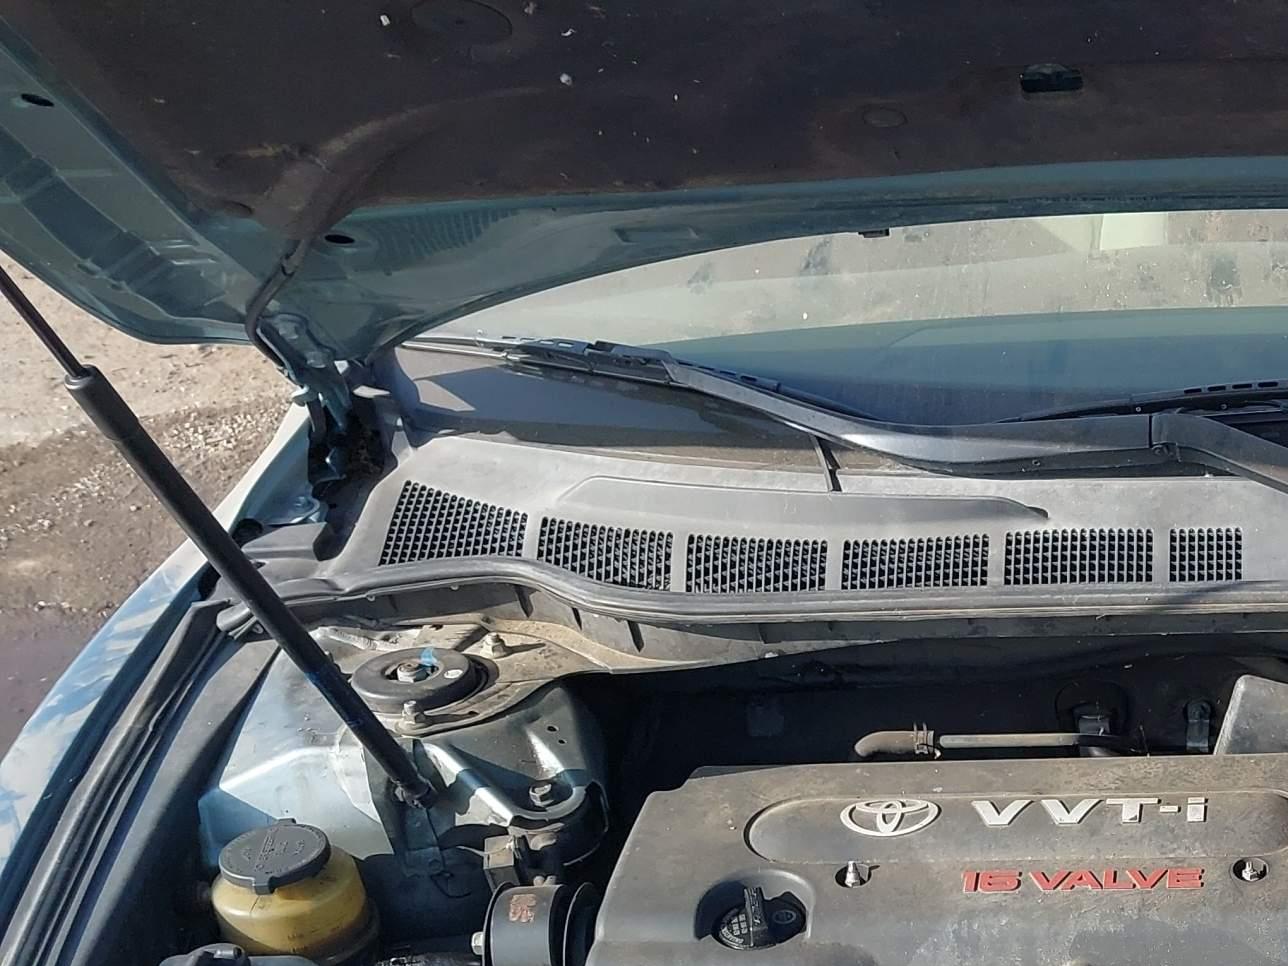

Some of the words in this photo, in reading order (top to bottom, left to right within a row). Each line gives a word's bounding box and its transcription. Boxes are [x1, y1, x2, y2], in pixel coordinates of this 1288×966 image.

[971, 797, 1209, 827] VVT-i
[961, 868, 1023, 893] 16
[1029, 866, 1205, 892] VALVE
